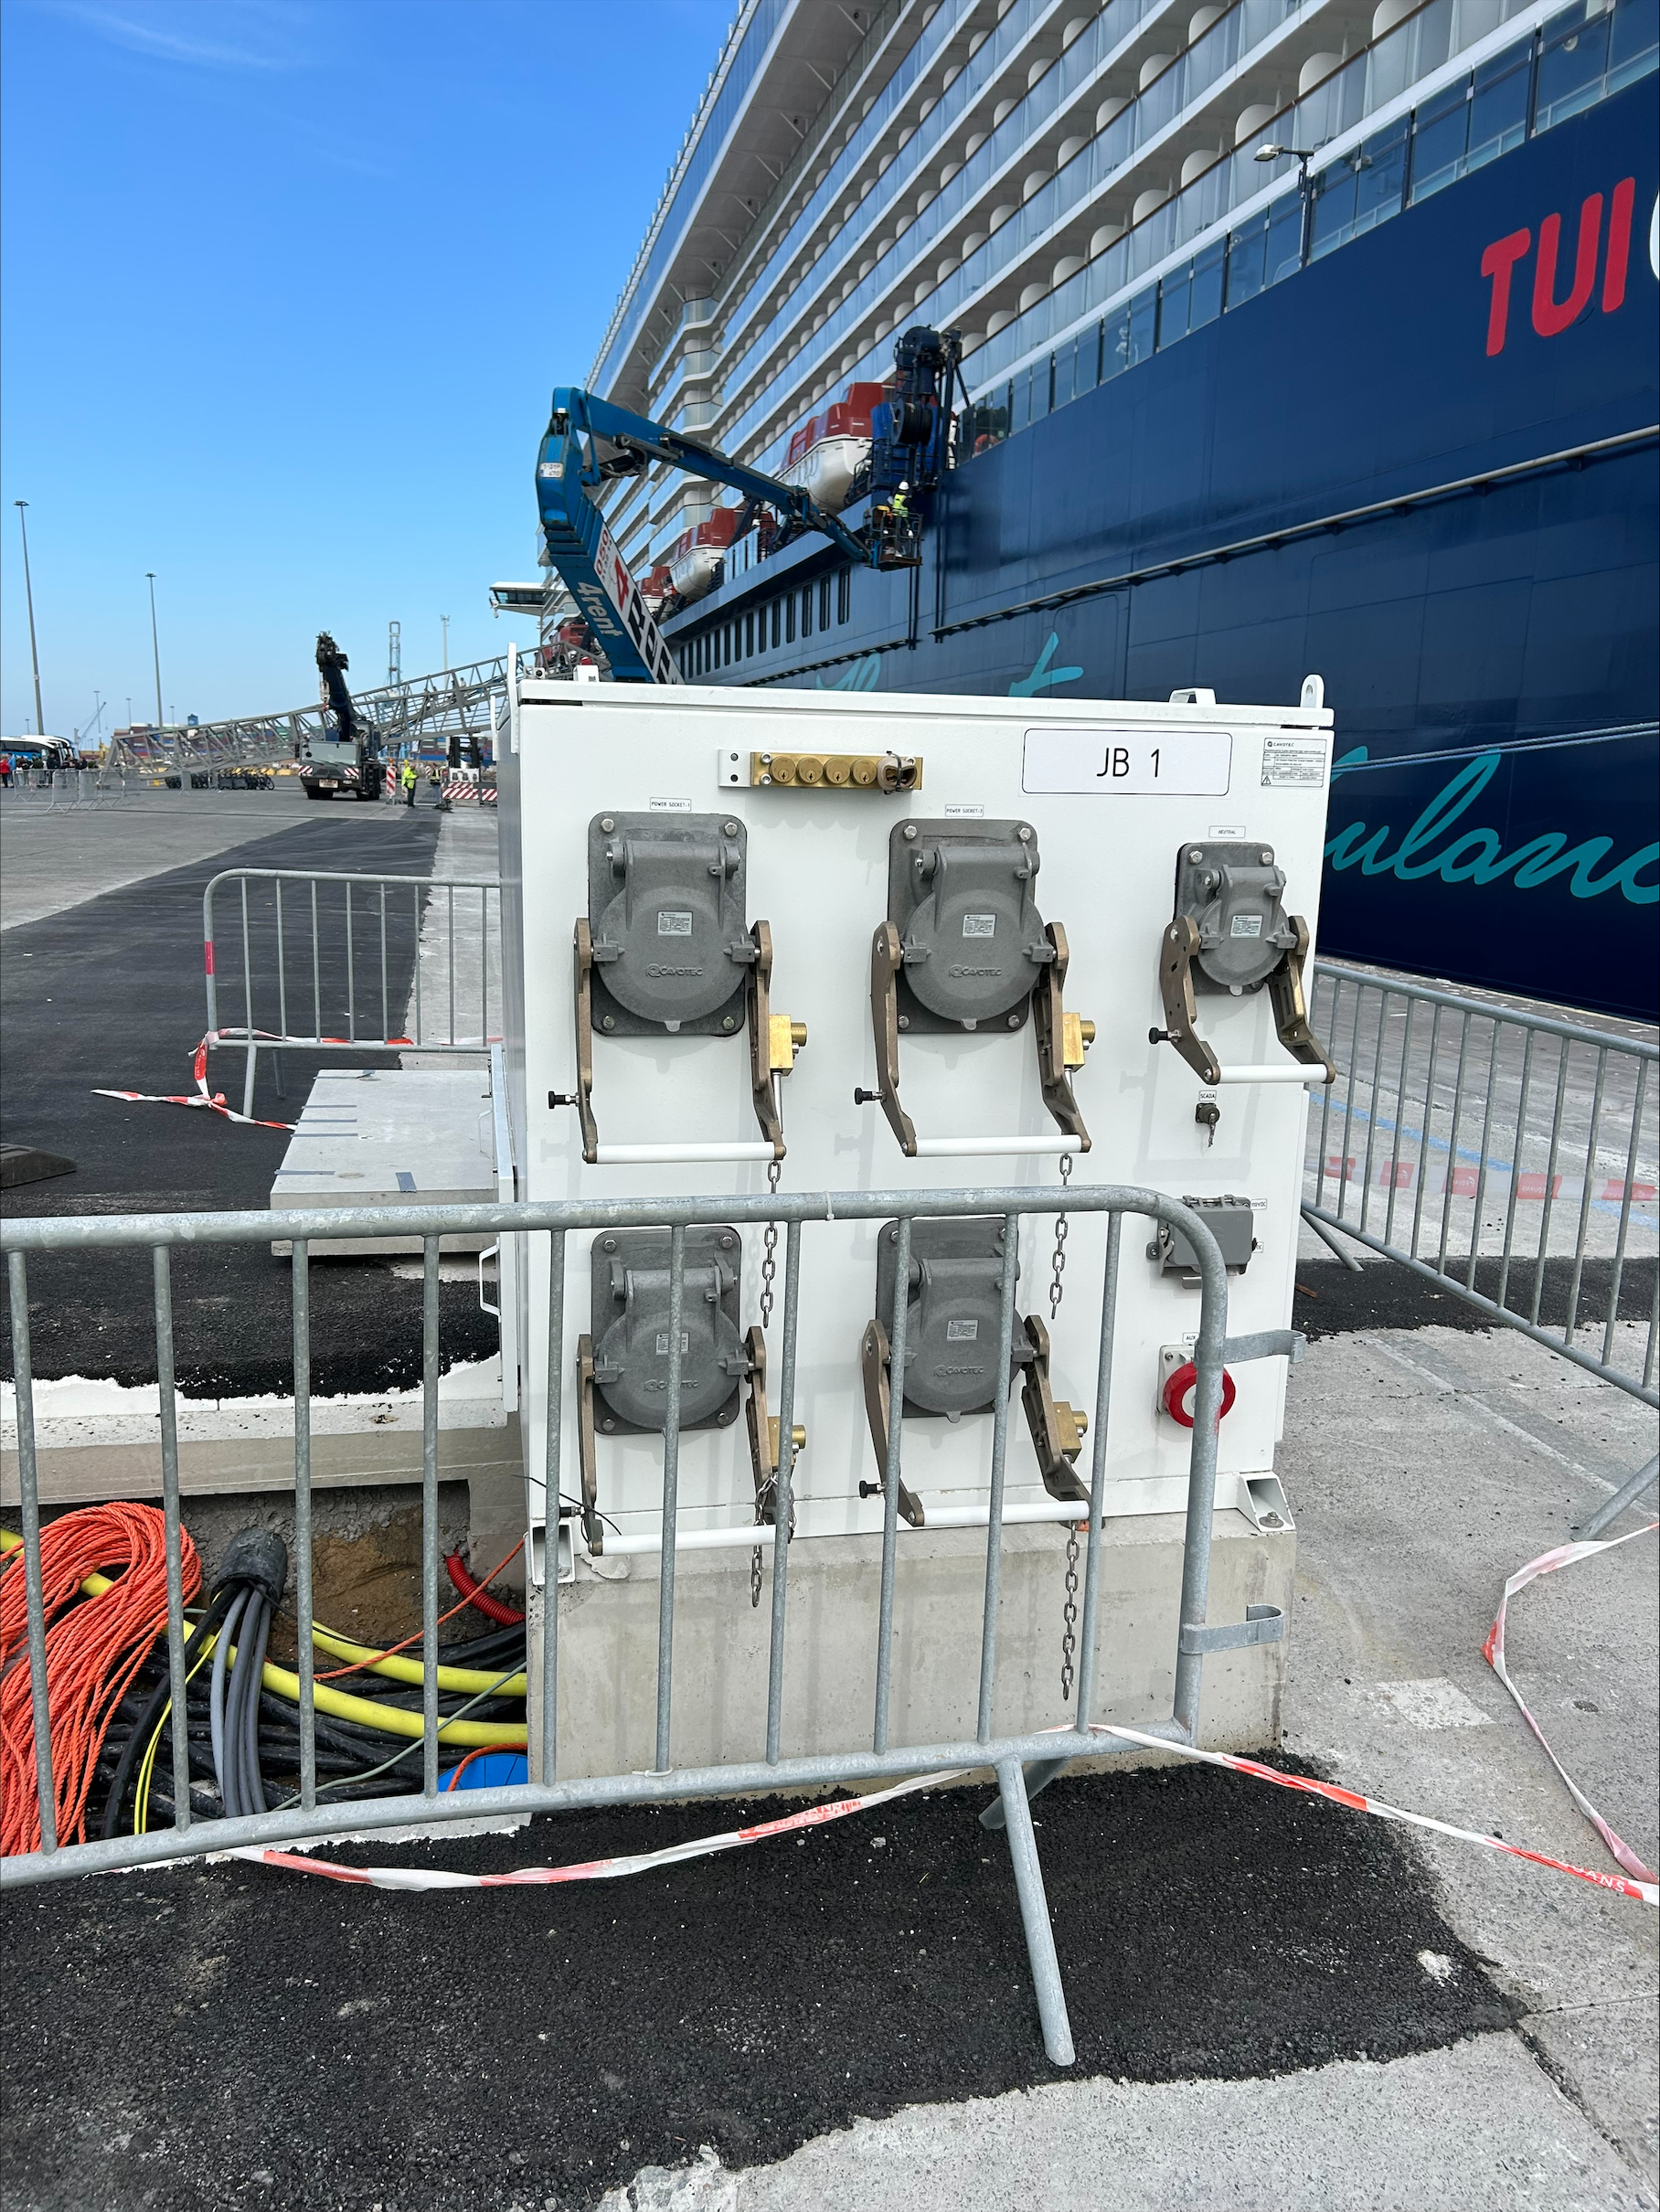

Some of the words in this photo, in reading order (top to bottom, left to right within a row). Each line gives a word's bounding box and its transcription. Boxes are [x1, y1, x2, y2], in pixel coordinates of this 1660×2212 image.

[1480, 175, 1636, 356] TUI
[1096, 747, 1130, 778] JB
[1150, 748, 1161, 778] 1
[659, 964, 703, 976] CAVOTEC
[962, 965, 1002, 976] CAVOTEC
[945, 1365, 984, 1375] CAVOTEC
